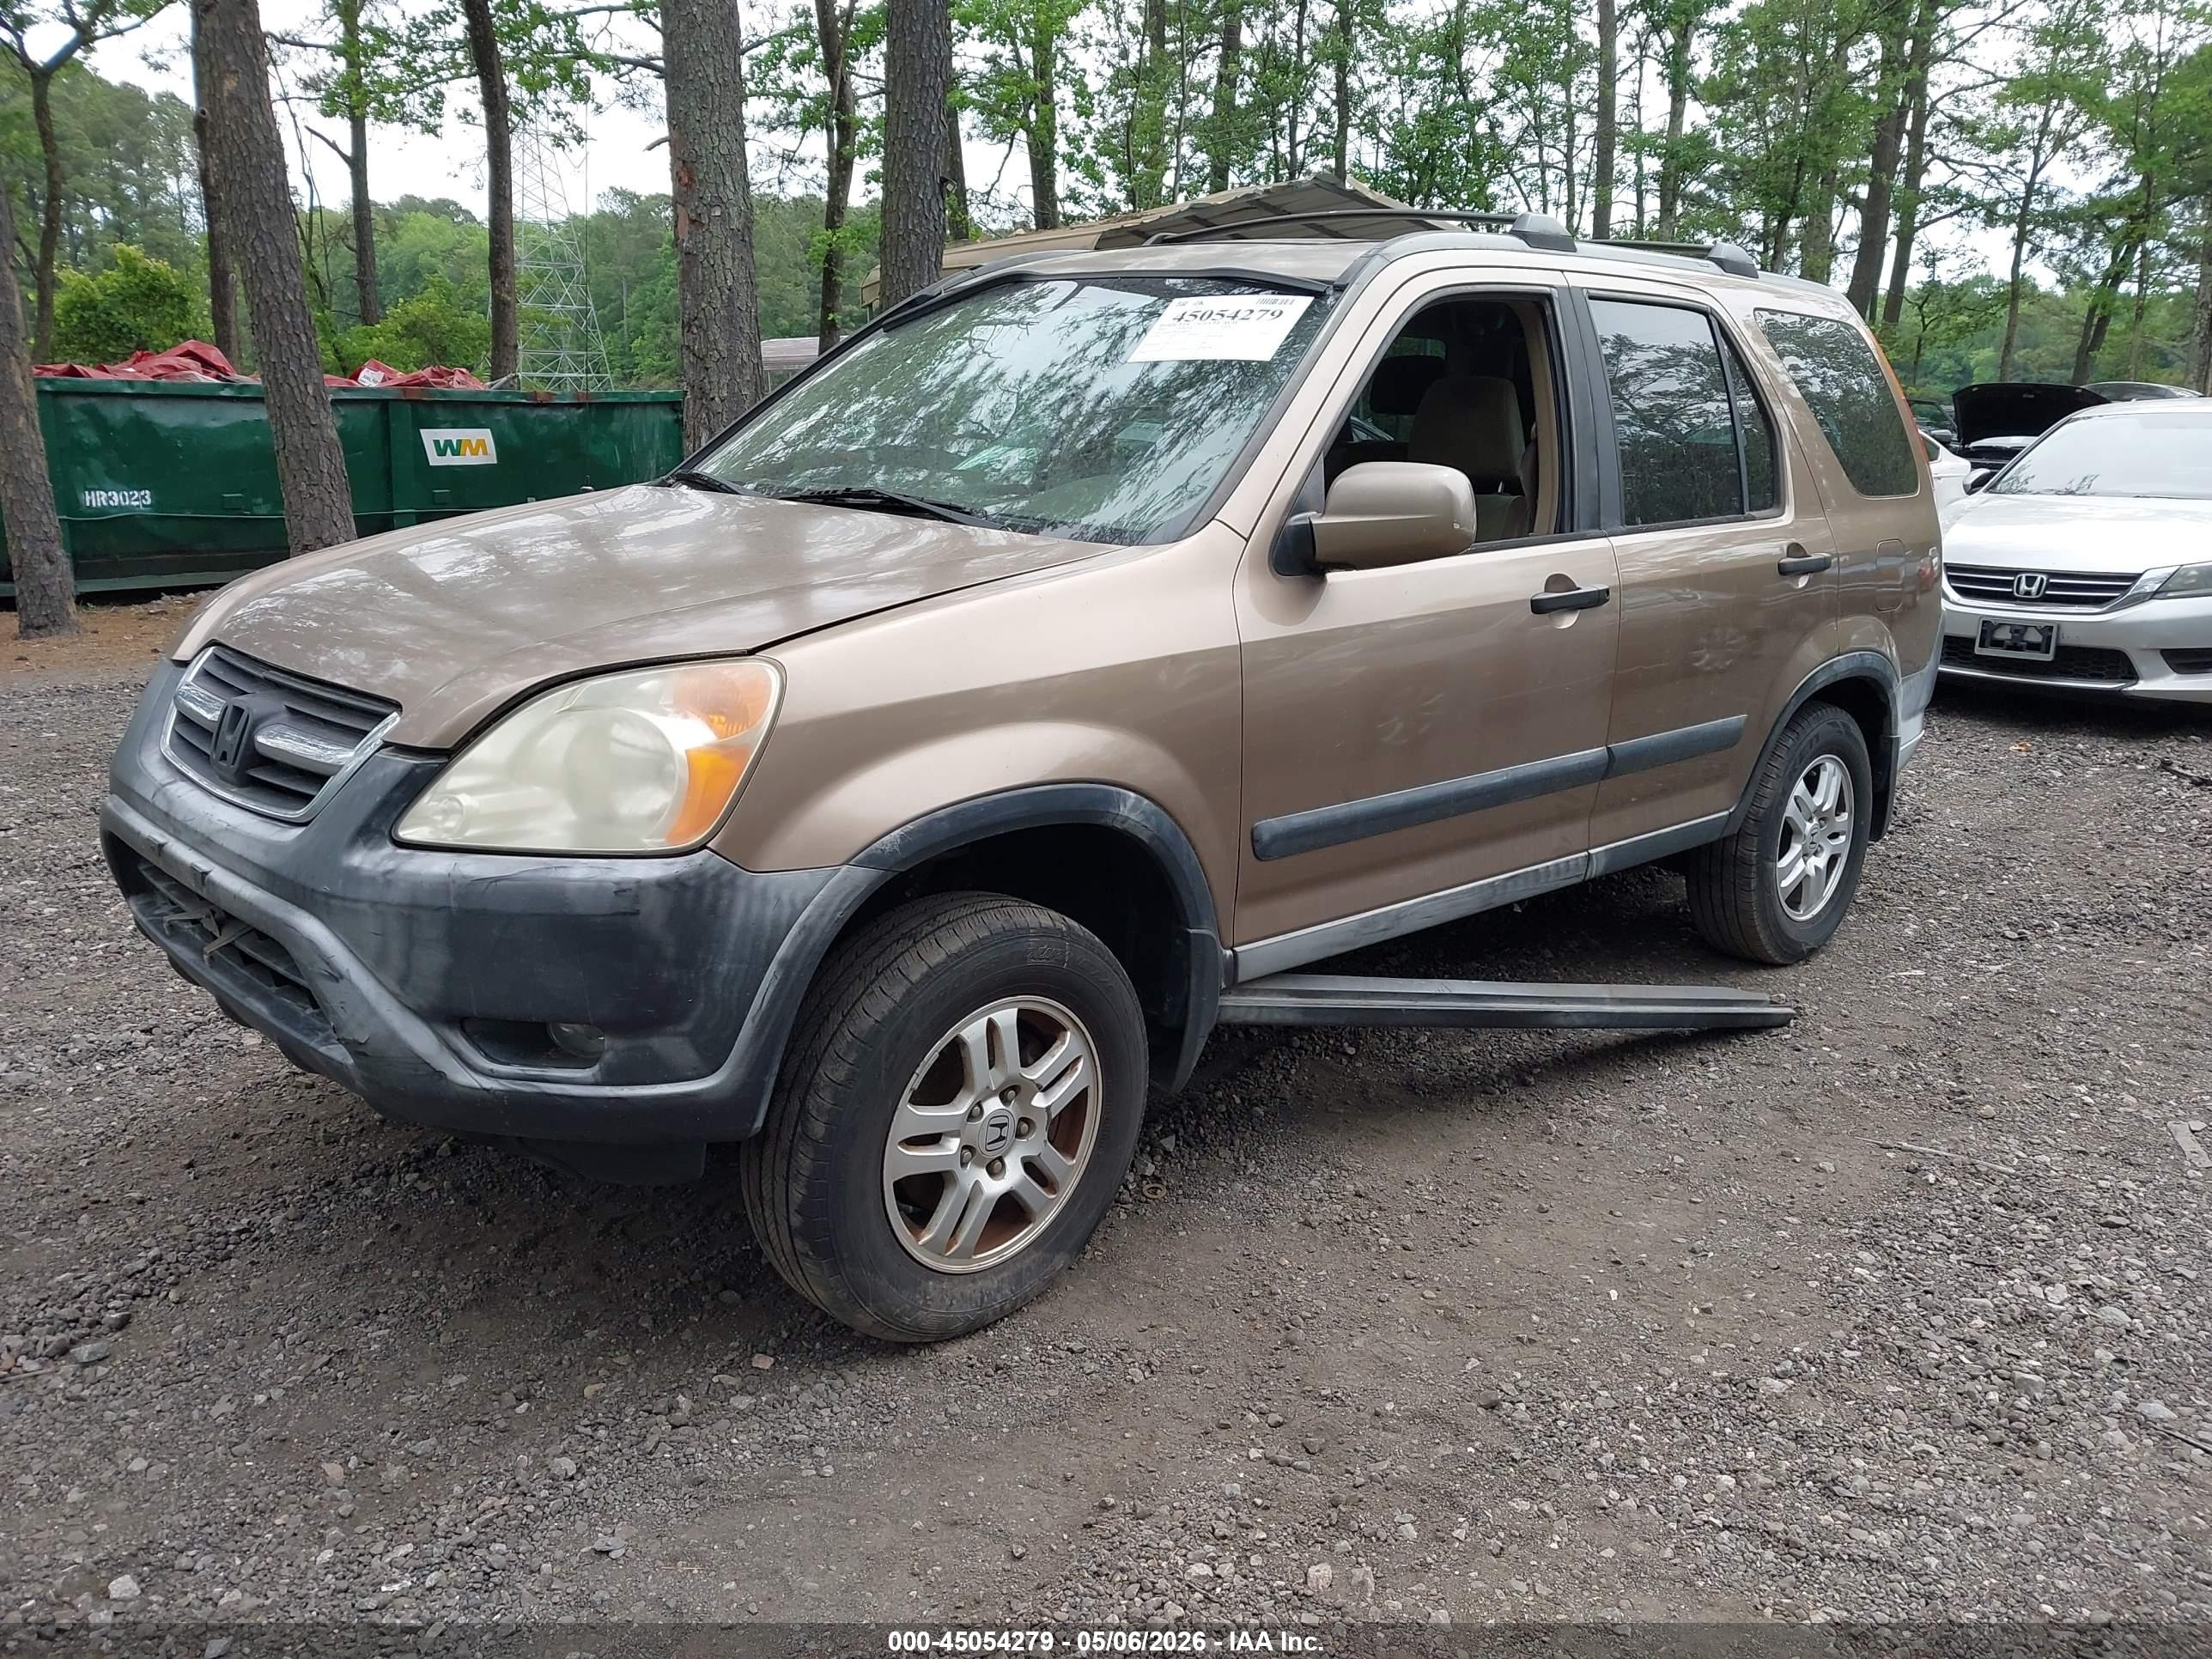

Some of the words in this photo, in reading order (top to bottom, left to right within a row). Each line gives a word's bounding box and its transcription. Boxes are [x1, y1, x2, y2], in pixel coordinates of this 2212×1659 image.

[1172, 308, 1284, 323] 45054279
[432, 439, 489, 457] WM
[84, 489, 152, 508] HR3023
